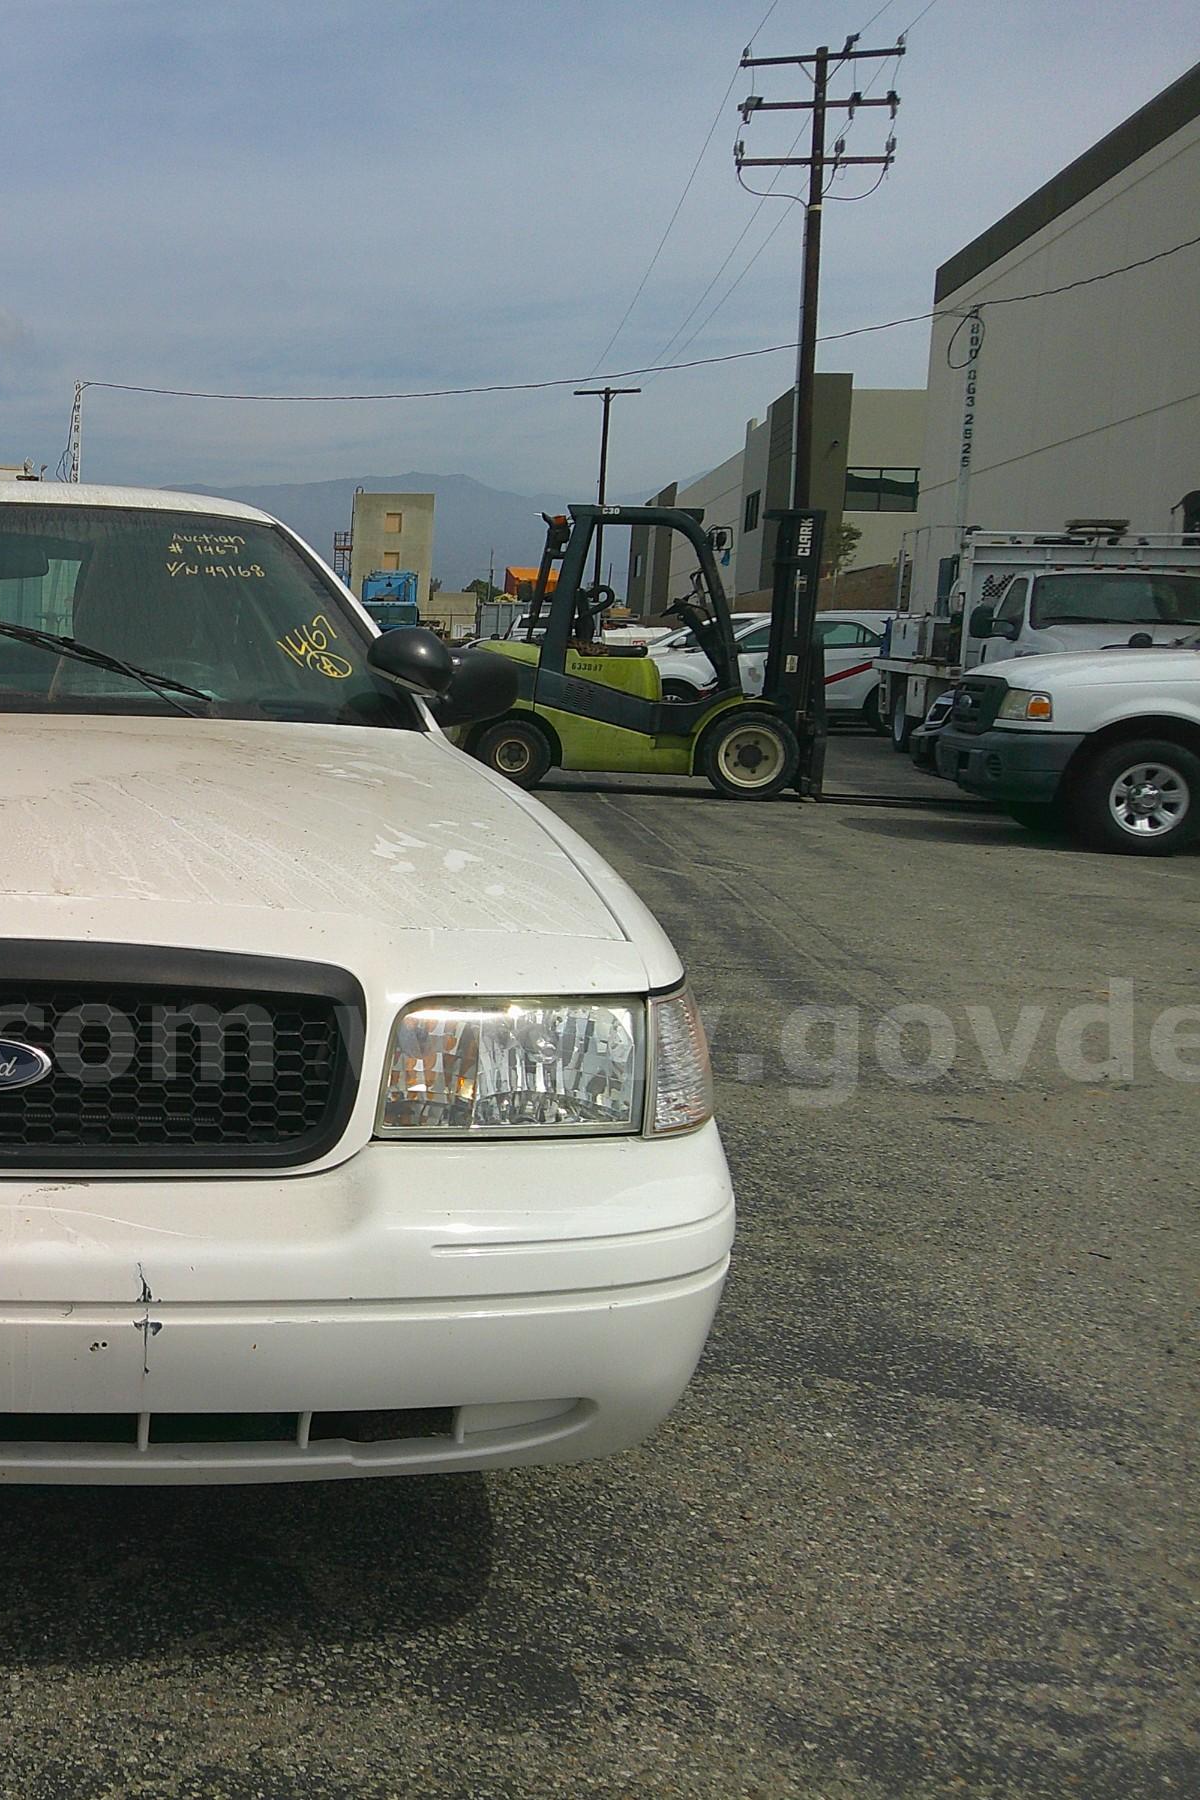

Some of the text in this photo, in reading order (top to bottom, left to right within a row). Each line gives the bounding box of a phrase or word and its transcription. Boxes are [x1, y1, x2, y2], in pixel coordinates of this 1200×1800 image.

[168, 542, 239, 555] # 1467
[797, 517, 814, 557] CLARK
[205, 564, 266, 578] 49168
[276, 614, 338, 668] 1467
